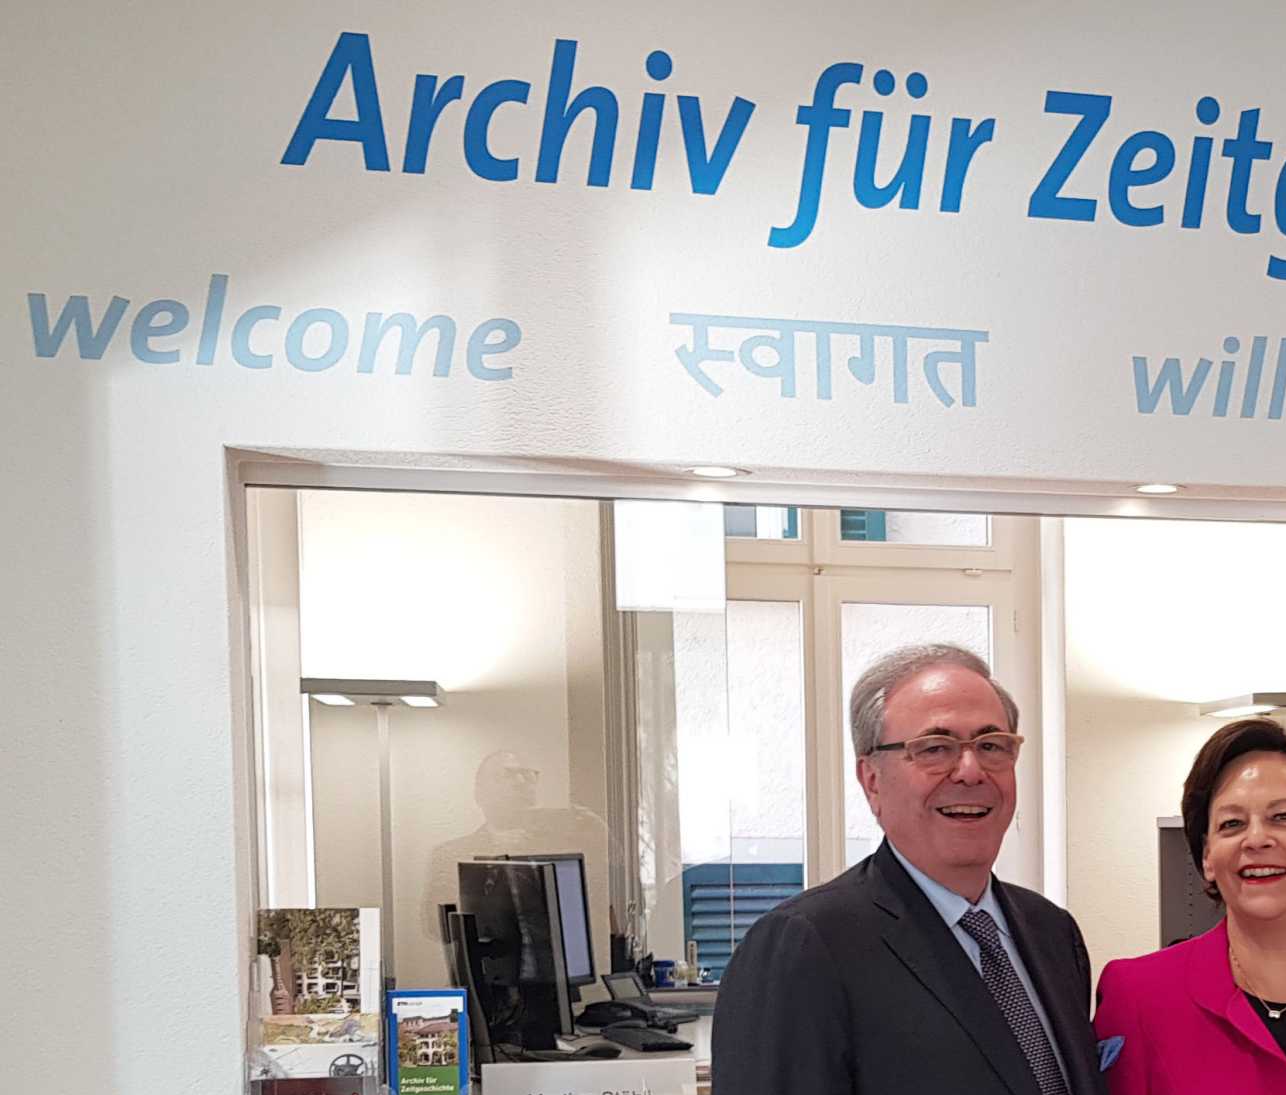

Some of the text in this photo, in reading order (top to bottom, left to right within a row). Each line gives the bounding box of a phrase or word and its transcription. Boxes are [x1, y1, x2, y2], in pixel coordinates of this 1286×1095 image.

[281, 32, 756, 197] Archiv
[768, 63, 997, 249] für
[28, 273, 522, 381] welcome
[669, 312, 991, 408] स्वागत
